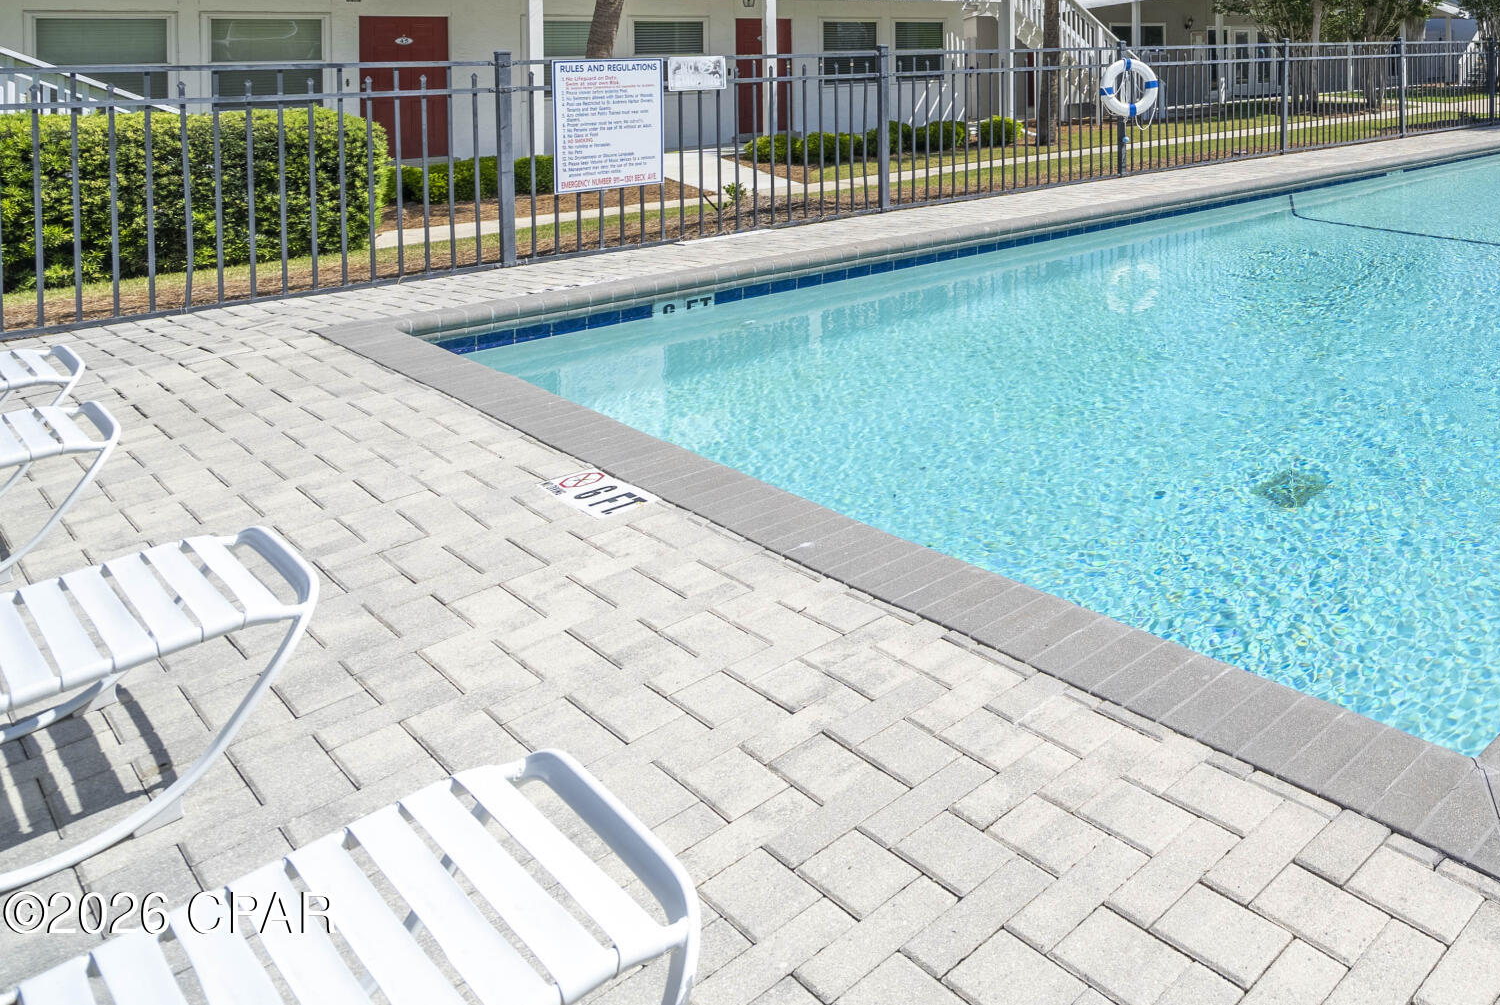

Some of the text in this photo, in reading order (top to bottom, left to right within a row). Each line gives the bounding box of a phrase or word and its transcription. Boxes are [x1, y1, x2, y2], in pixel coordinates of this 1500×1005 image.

[561, 180, 589, 189] EMERGENCY
[592, 177, 611, 185] NUMBER
[574, 485, 618, 500] 6
